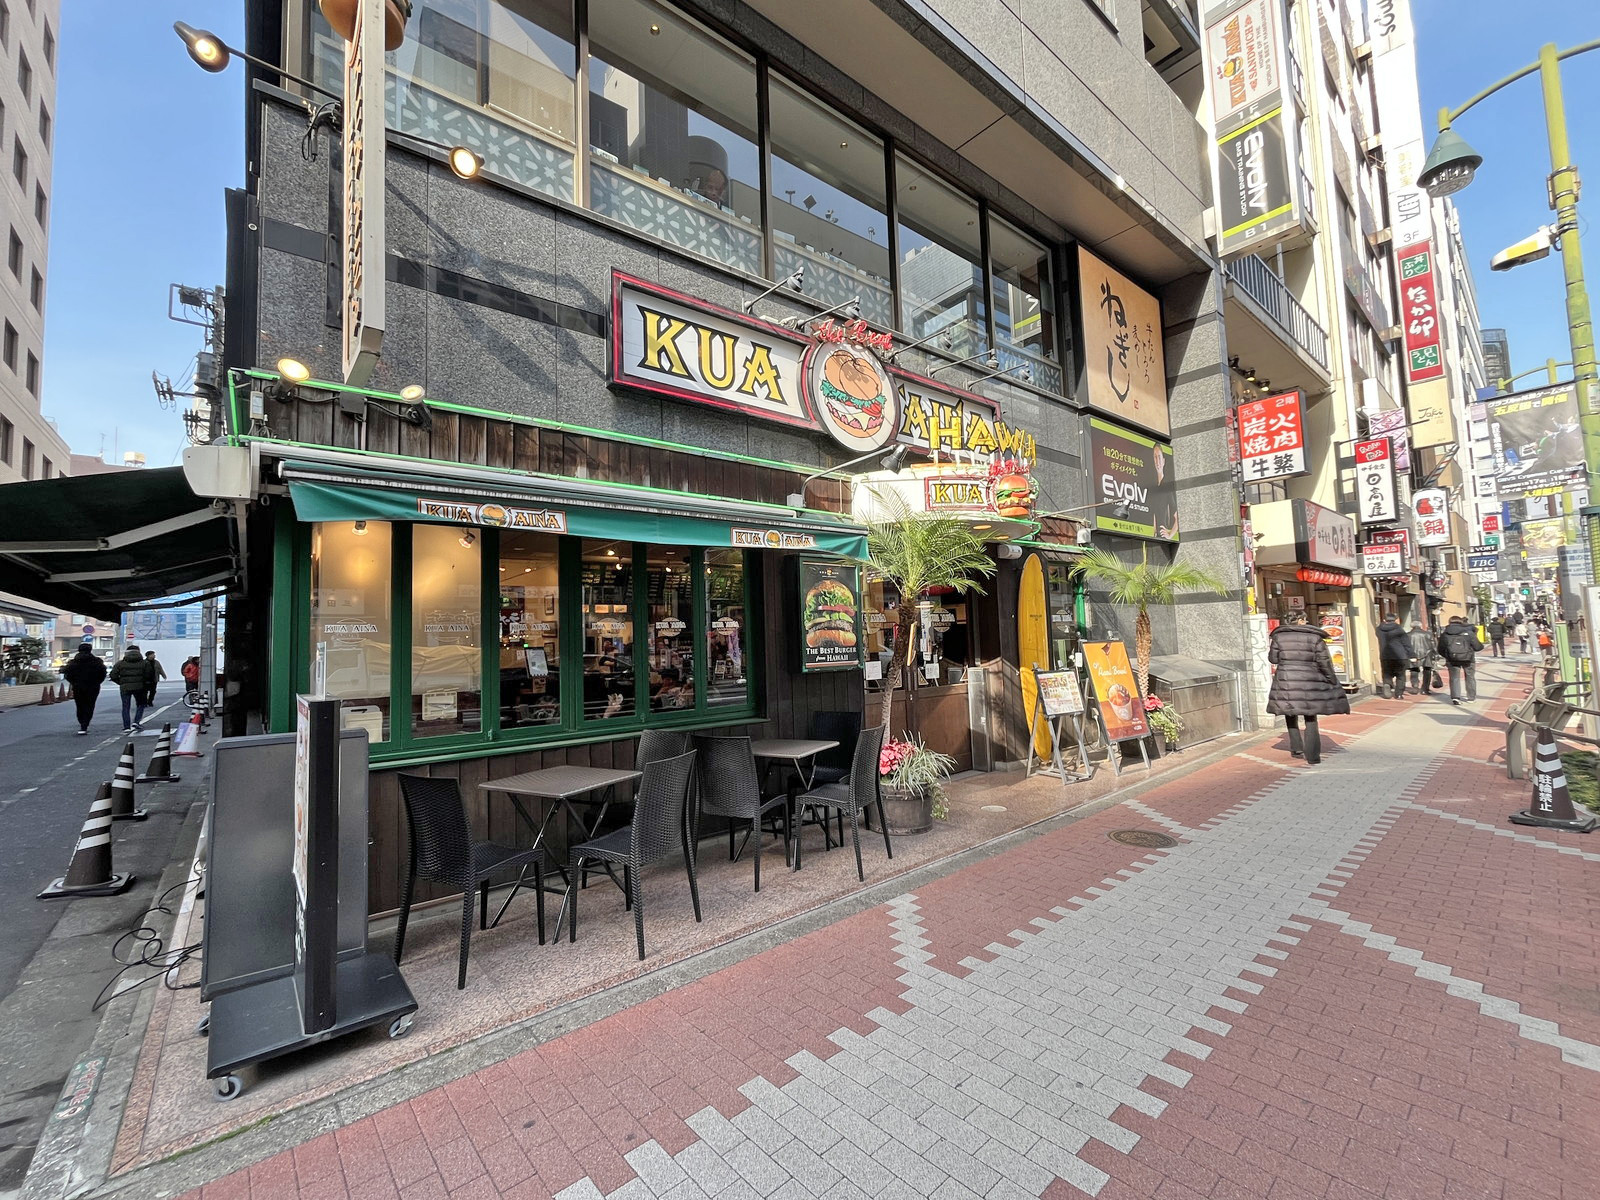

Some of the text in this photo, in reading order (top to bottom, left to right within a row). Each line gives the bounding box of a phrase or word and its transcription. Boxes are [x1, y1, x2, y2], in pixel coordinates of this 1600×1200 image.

[1244, 25, 1257, 80] SANDWICH
[1229, 69, 1246, 109] KUA
[1237, 157, 1245, 190] TRAINING
[1239, 190, 1248, 217] STUDIO
[1403, 231, 1419, 243] 3F
[1407, 286, 1434, 338] なか卯
[1100, 277, 1130, 403] ねぎし
[637, 305, 788, 405] KUA
[1275, 396, 1295, 408] 2階
[1243, 412, 1296, 437] 炭火
[1244, 431, 1297, 456] 焼肉
[1252, 453, 1294, 477] 牛繁
[935, 483, 984, 504] KUA
[1102, 474, 1147, 503] Evolv
[1366, 473, 1387, 518] 日高屋
[426, 504, 472, 523] KUA
[735, 531, 762, 545] KUA
[1472, 558, 1496, 567] TBC
[827, 653, 848, 662] HAWAII
